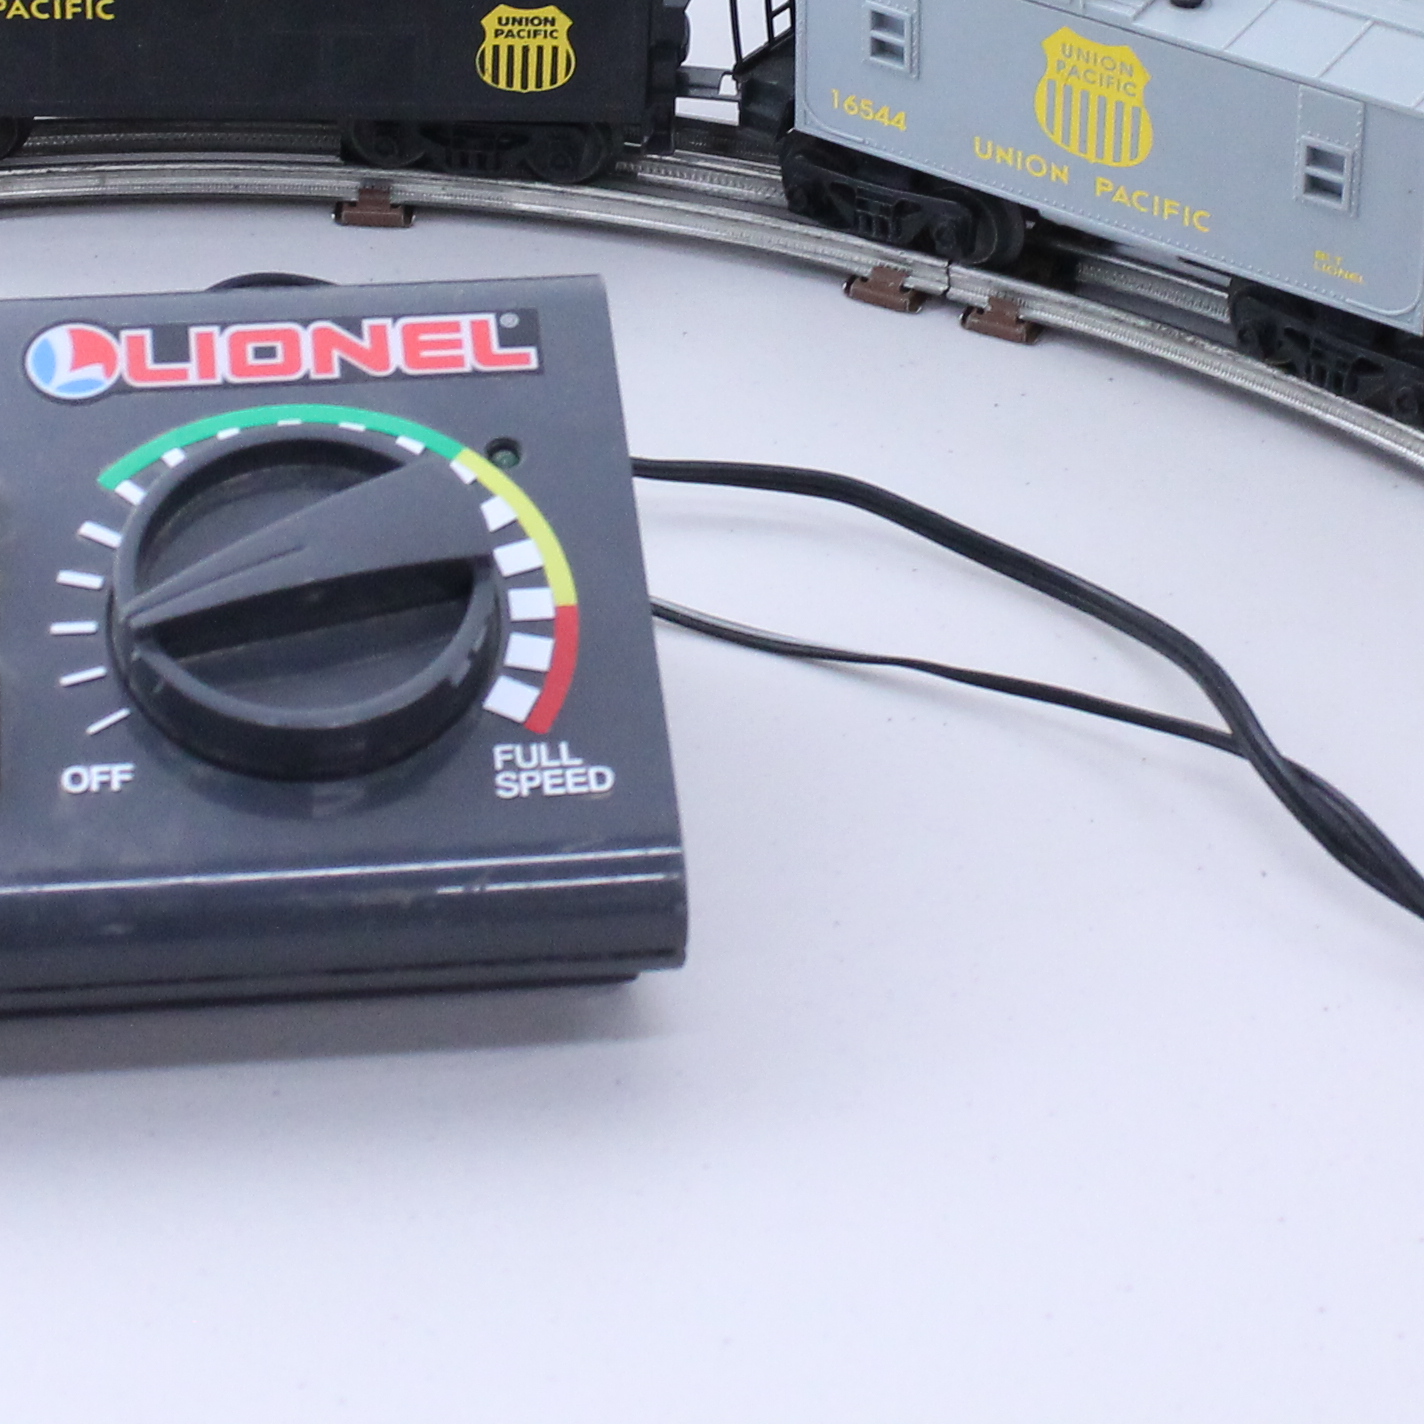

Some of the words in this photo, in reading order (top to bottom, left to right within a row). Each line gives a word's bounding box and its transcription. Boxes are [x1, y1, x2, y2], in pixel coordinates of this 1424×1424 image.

[494, 28, 559, 39] PACIFIC
[497, 16, 556, 27] UNION
[1060, 43, 1135, 77] UNION
[1056, 58, 1138, 98] PACIFIC
[830, 89, 908, 132] 16544
[974, 136, 1070, 185] UNION
[1095, 176, 1213, 234] PACIFIC
[120, 313, 539, 387] LIONEL
[492, 740, 584, 771] FULL
[60, 762, 136, 794] OFF
[494, 764, 616, 799] SPEED
